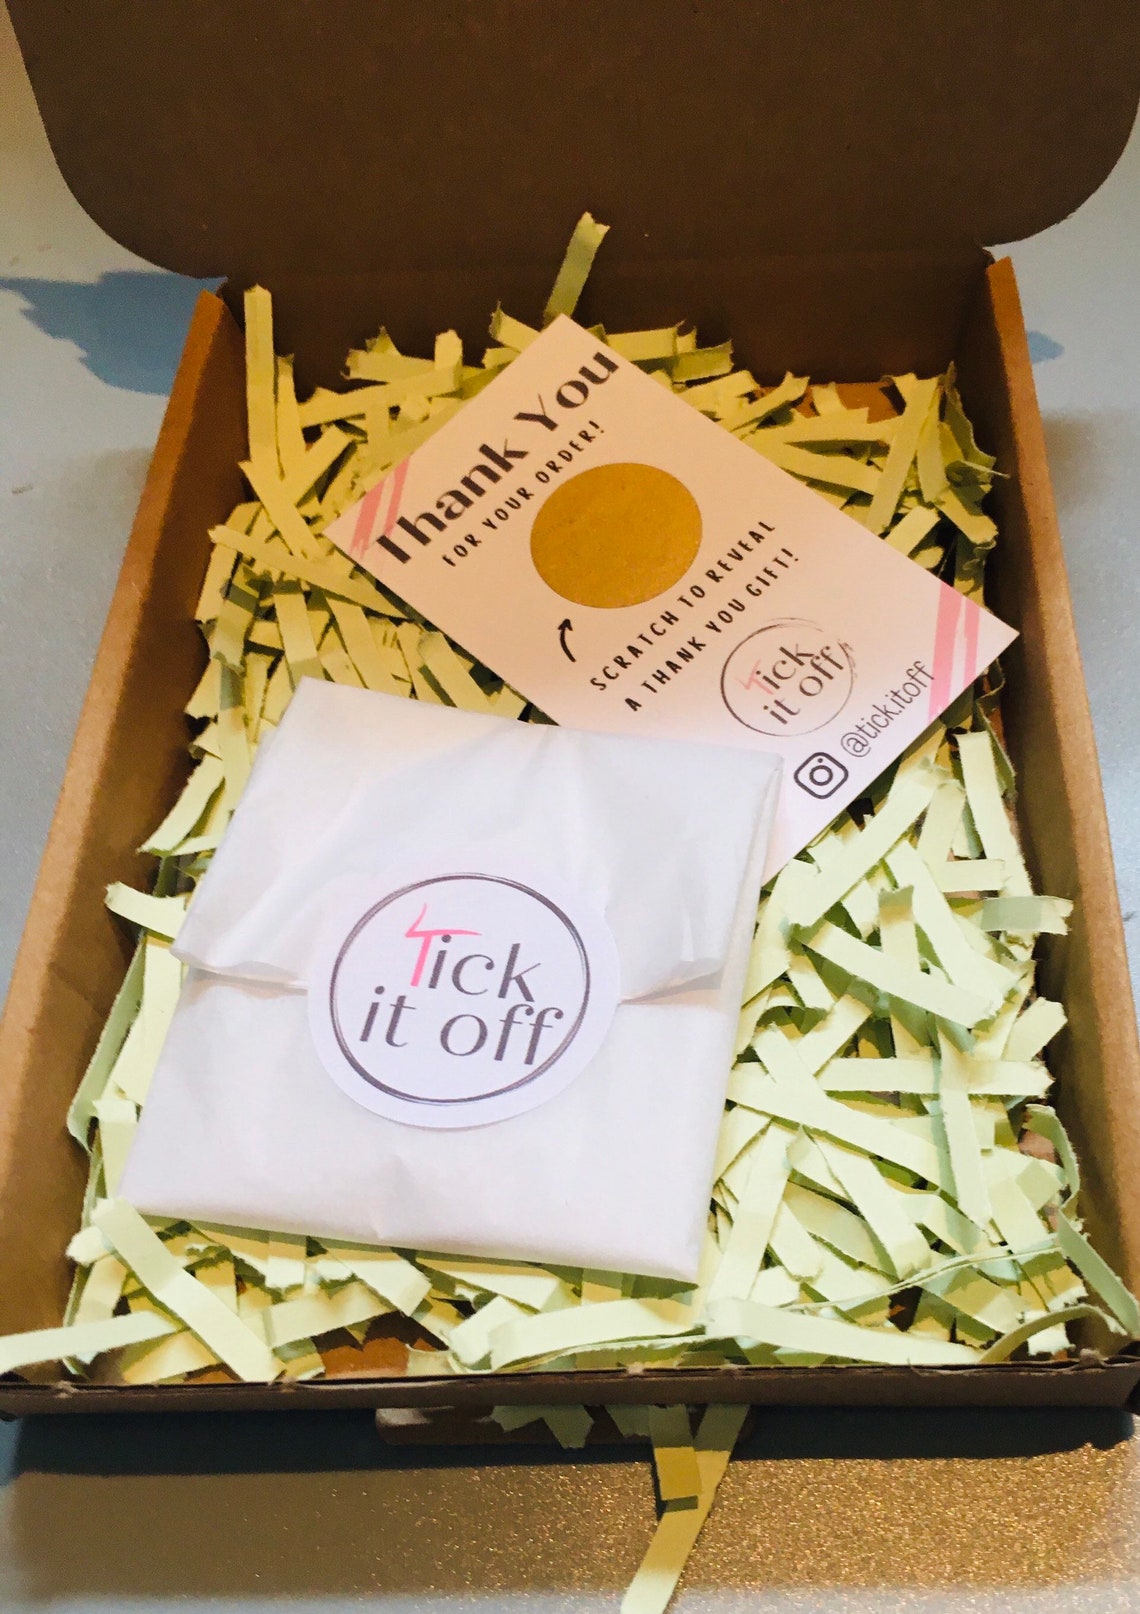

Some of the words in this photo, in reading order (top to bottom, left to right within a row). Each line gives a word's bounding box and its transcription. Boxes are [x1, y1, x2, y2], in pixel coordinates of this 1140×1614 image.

[376, 438, 530, 564] Thank
[513, 351, 620, 431] You
[442, 533, 482, 567] FOR
[482, 487, 534, 530] YOUR
[535, 420, 605, 484] ORDER!
[590, 611, 679, 691] SCRATCH
[677, 585, 706, 608] TO
[706, 521, 775, 583] REVEAL
[624, 697, 643, 712] A
[641, 636, 706, 693] THANK
[706, 599, 746, 633] YOU
[745, 548, 799, 597] GIFT!
[736, 643, 815, 695] Tick
[763, 697, 800, 725] it
[799, 645, 844, 697] off
[840, 661, 934, 758] @tick.itoff
[405, 902, 541, 1002] Tick
[359, 985, 416, 1047] it
[440, 1003, 564, 1065] off
